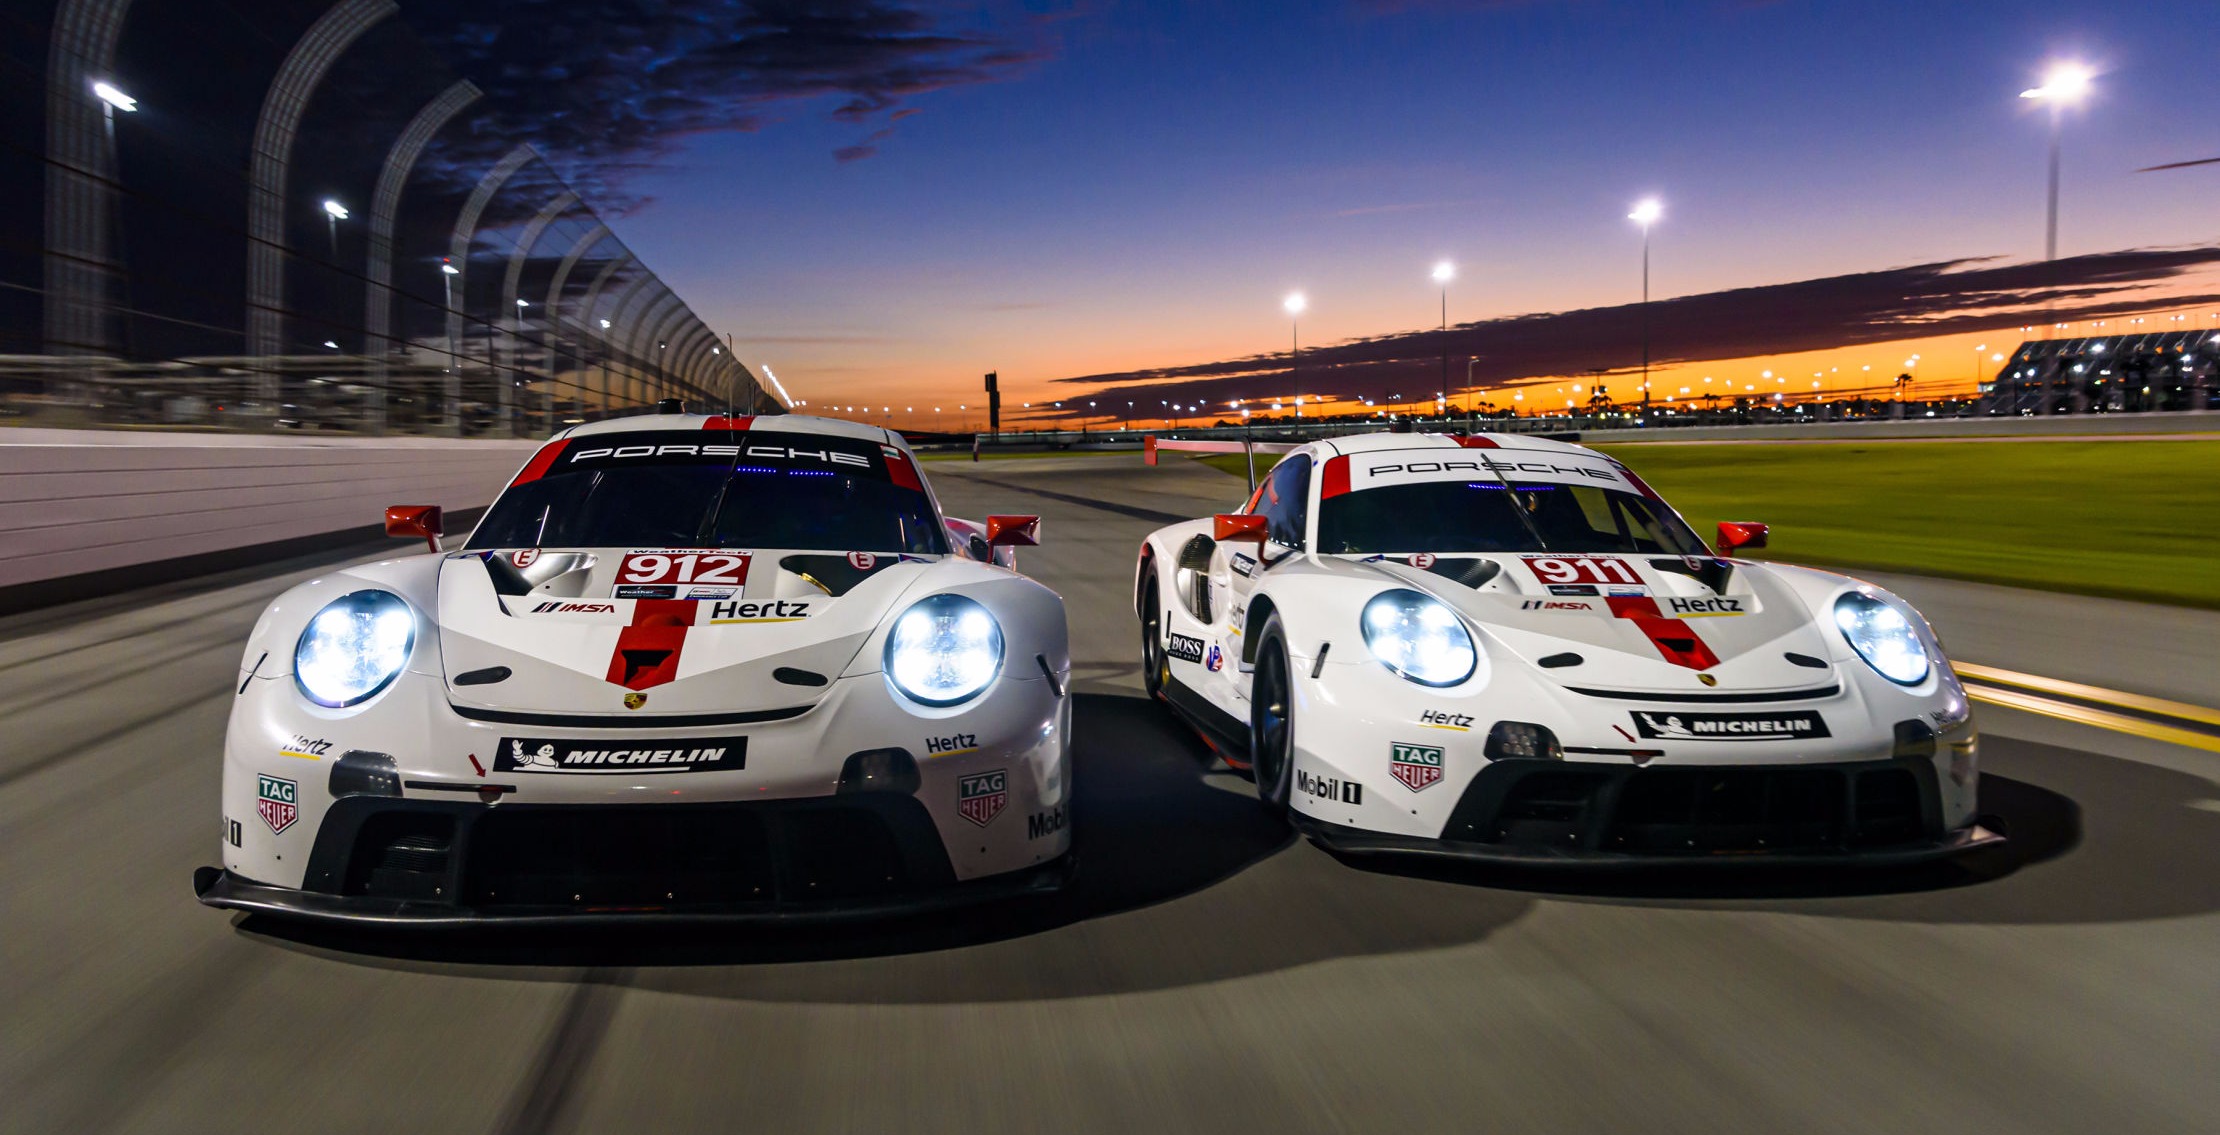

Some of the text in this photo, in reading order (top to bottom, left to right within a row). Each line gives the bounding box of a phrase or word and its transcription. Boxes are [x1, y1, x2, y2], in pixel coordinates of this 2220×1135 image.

[570, 445, 870, 468] PORSCHE
[1369, 461, 1619, 482] PORSCHE
[517, 550, 534, 565] E
[856, 552, 870, 567] E
[624, 554, 743, 584] 912
[1533, 559, 1638, 583] 911
[557, 603, 616, 614] IMSA
[711, 600, 810, 619] Hertz
[1544, 602, 1593, 611] IMSA
[1668, 597, 1745, 613] Hertz
[1171, 635, 1202, 656] BOSS
[1420, 709, 1476, 729] Hertz
[1692, 719, 1812, 733] MICHELIN
[925, 733, 979, 753] Hertz
[563, 747, 727, 765] MICHELIN
[1394, 746, 1439, 765] TAG
[963, 775, 1004, 796] TAG
[1297, 768, 1338, 801] Mobil
[1393, 763, 1440, 789] HEUER
[260, 779, 293, 802] TAG
[259, 799, 295, 829] HEUER
[962, 795, 1006, 822] HEUER
